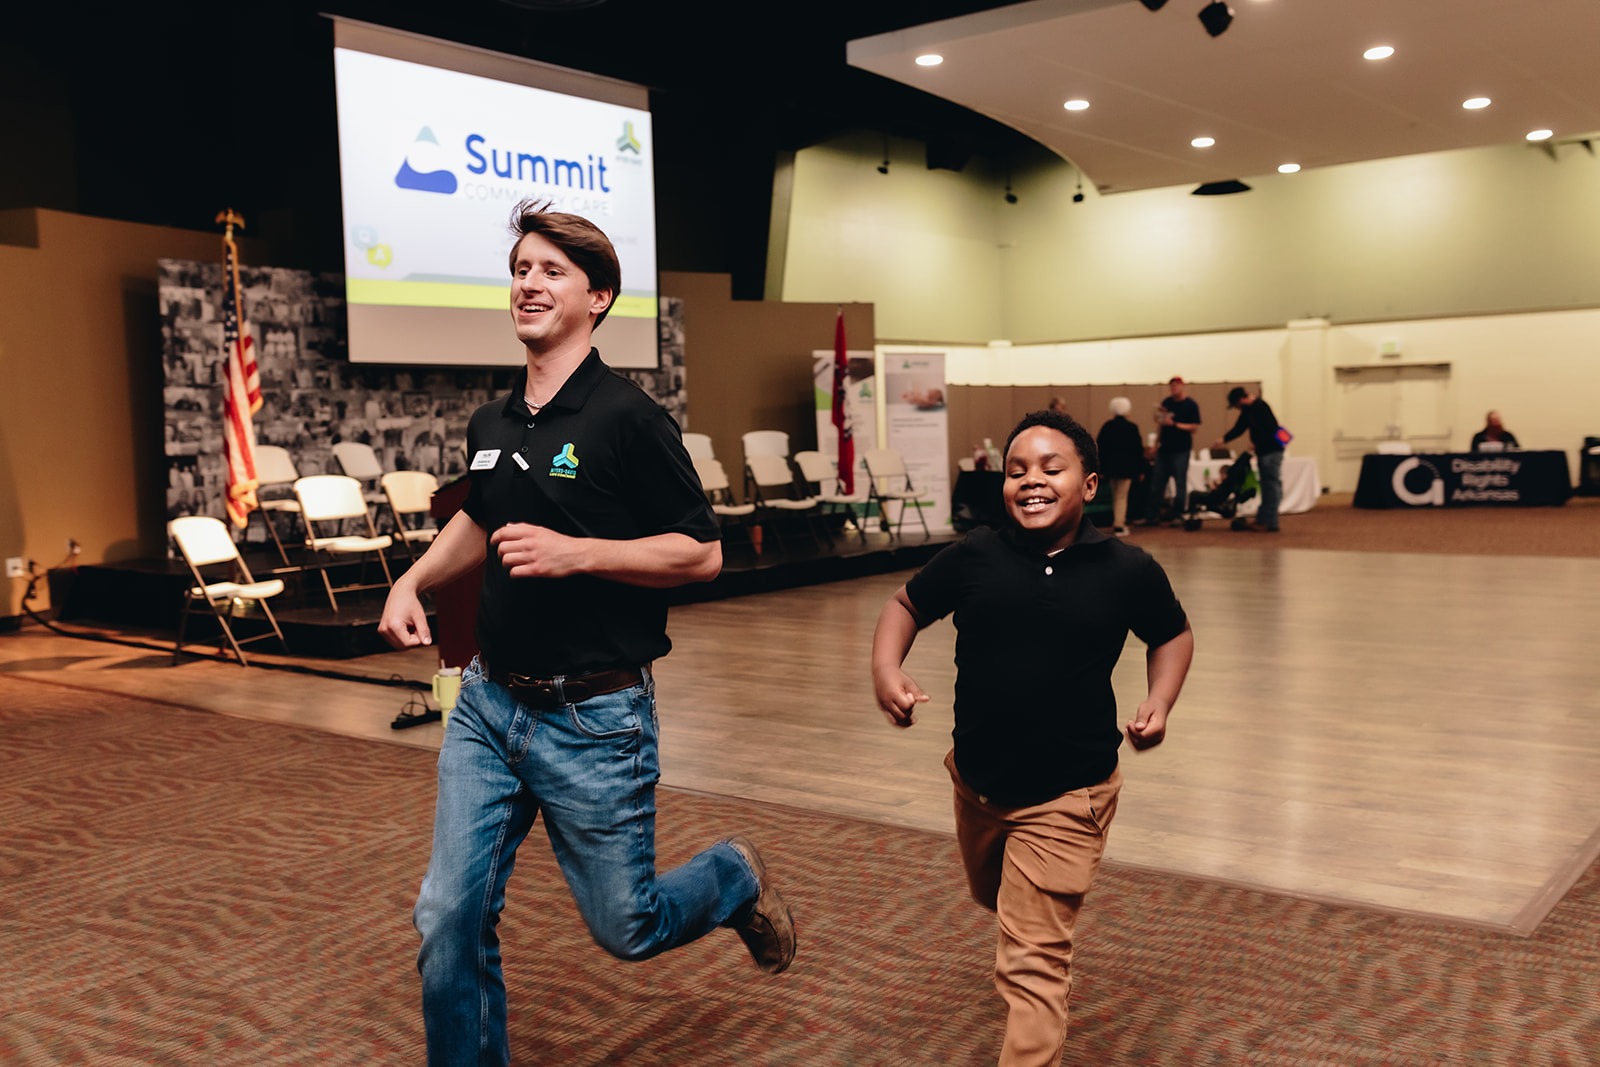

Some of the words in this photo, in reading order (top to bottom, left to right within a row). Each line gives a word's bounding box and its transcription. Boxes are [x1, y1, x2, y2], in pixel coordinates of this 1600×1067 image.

[465, 133, 611, 193] Summit
[571, 196, 609, 217] CARE
[1451, 458, 1521, 475] Disability
